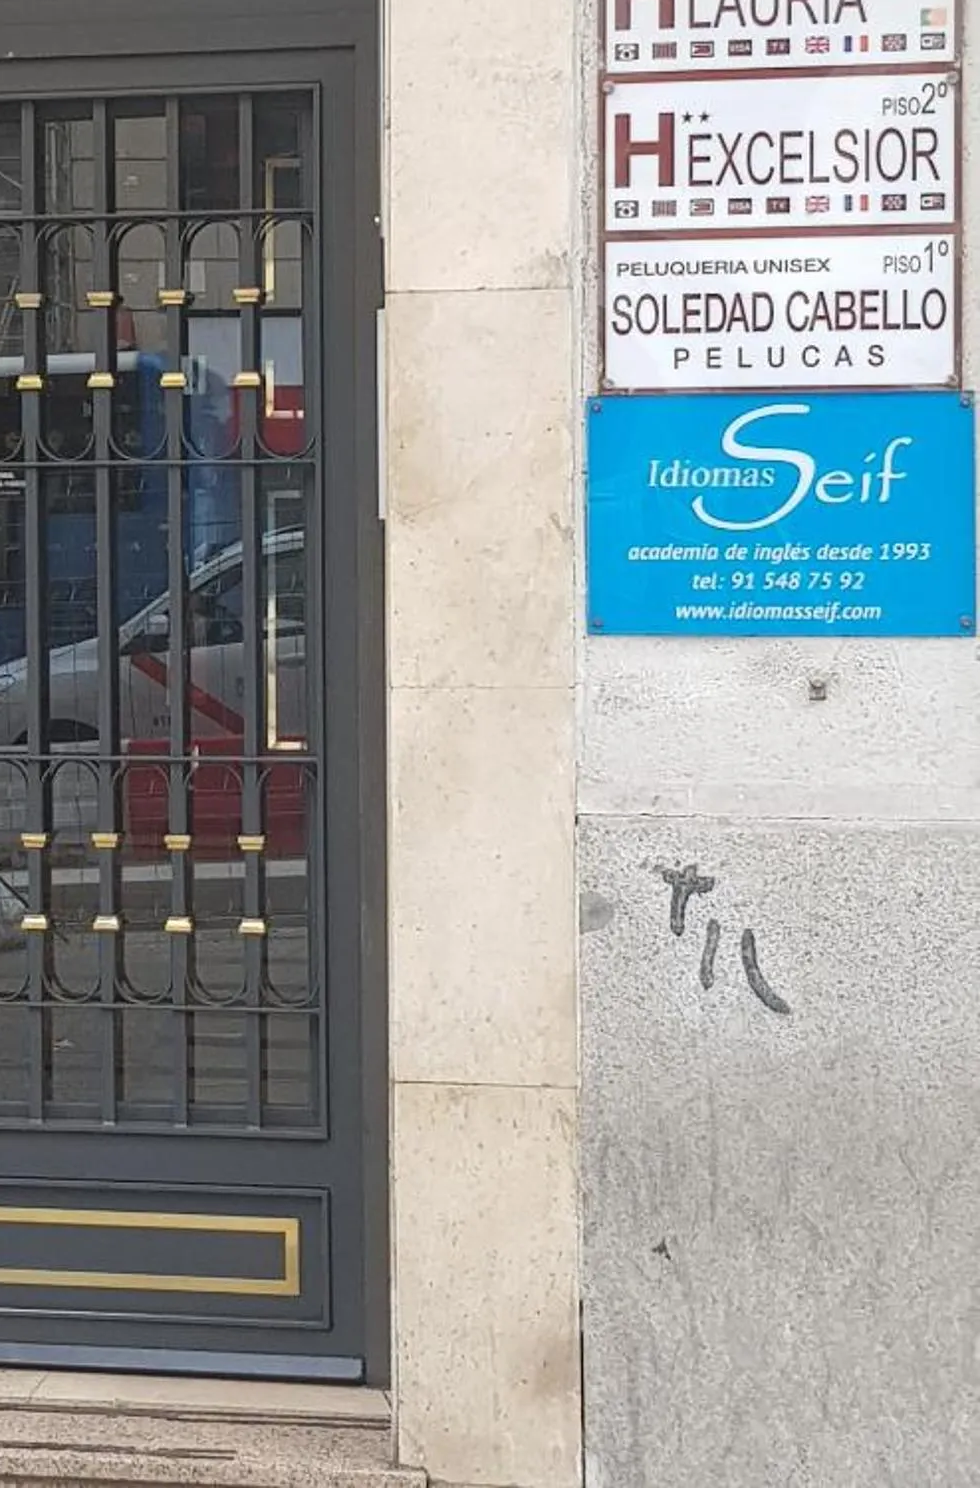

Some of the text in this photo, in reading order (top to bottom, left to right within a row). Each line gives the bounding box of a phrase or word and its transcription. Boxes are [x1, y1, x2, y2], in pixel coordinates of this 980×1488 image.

[616, 259, 749, 277] PELUQUERIA
[753, 257, 832, 275] UNISEX
[612, 288, 947, 335] SOLEDAD CABELLO
[673, 344, 886, 370] PELUCAS
[648, 459, 777, 488] Idiomas
[627, 543, 931, 564] academia de inglés desde 1993
[731, 572, 755, 590] 91
[763, 572, 801, 590] 548
[807, 572, 833, 590] 75
[839, 572, 866, 590] 92
[675, 601, 882, 623] www.idiomasseif.com
